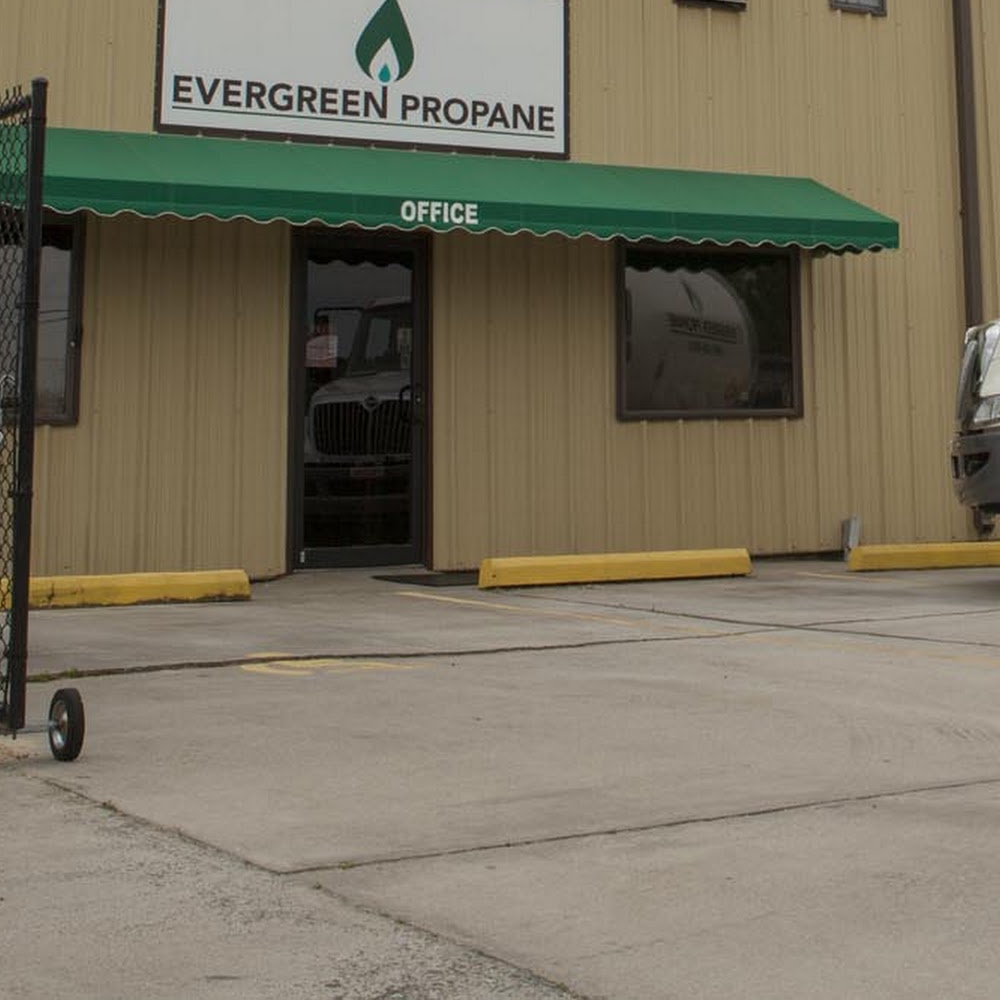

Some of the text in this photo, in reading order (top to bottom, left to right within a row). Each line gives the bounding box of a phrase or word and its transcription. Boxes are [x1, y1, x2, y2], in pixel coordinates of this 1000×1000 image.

[172, 75, 556, 132] EVERGREEN PROPANE
[400, 201, 479, 225] OFFICE
